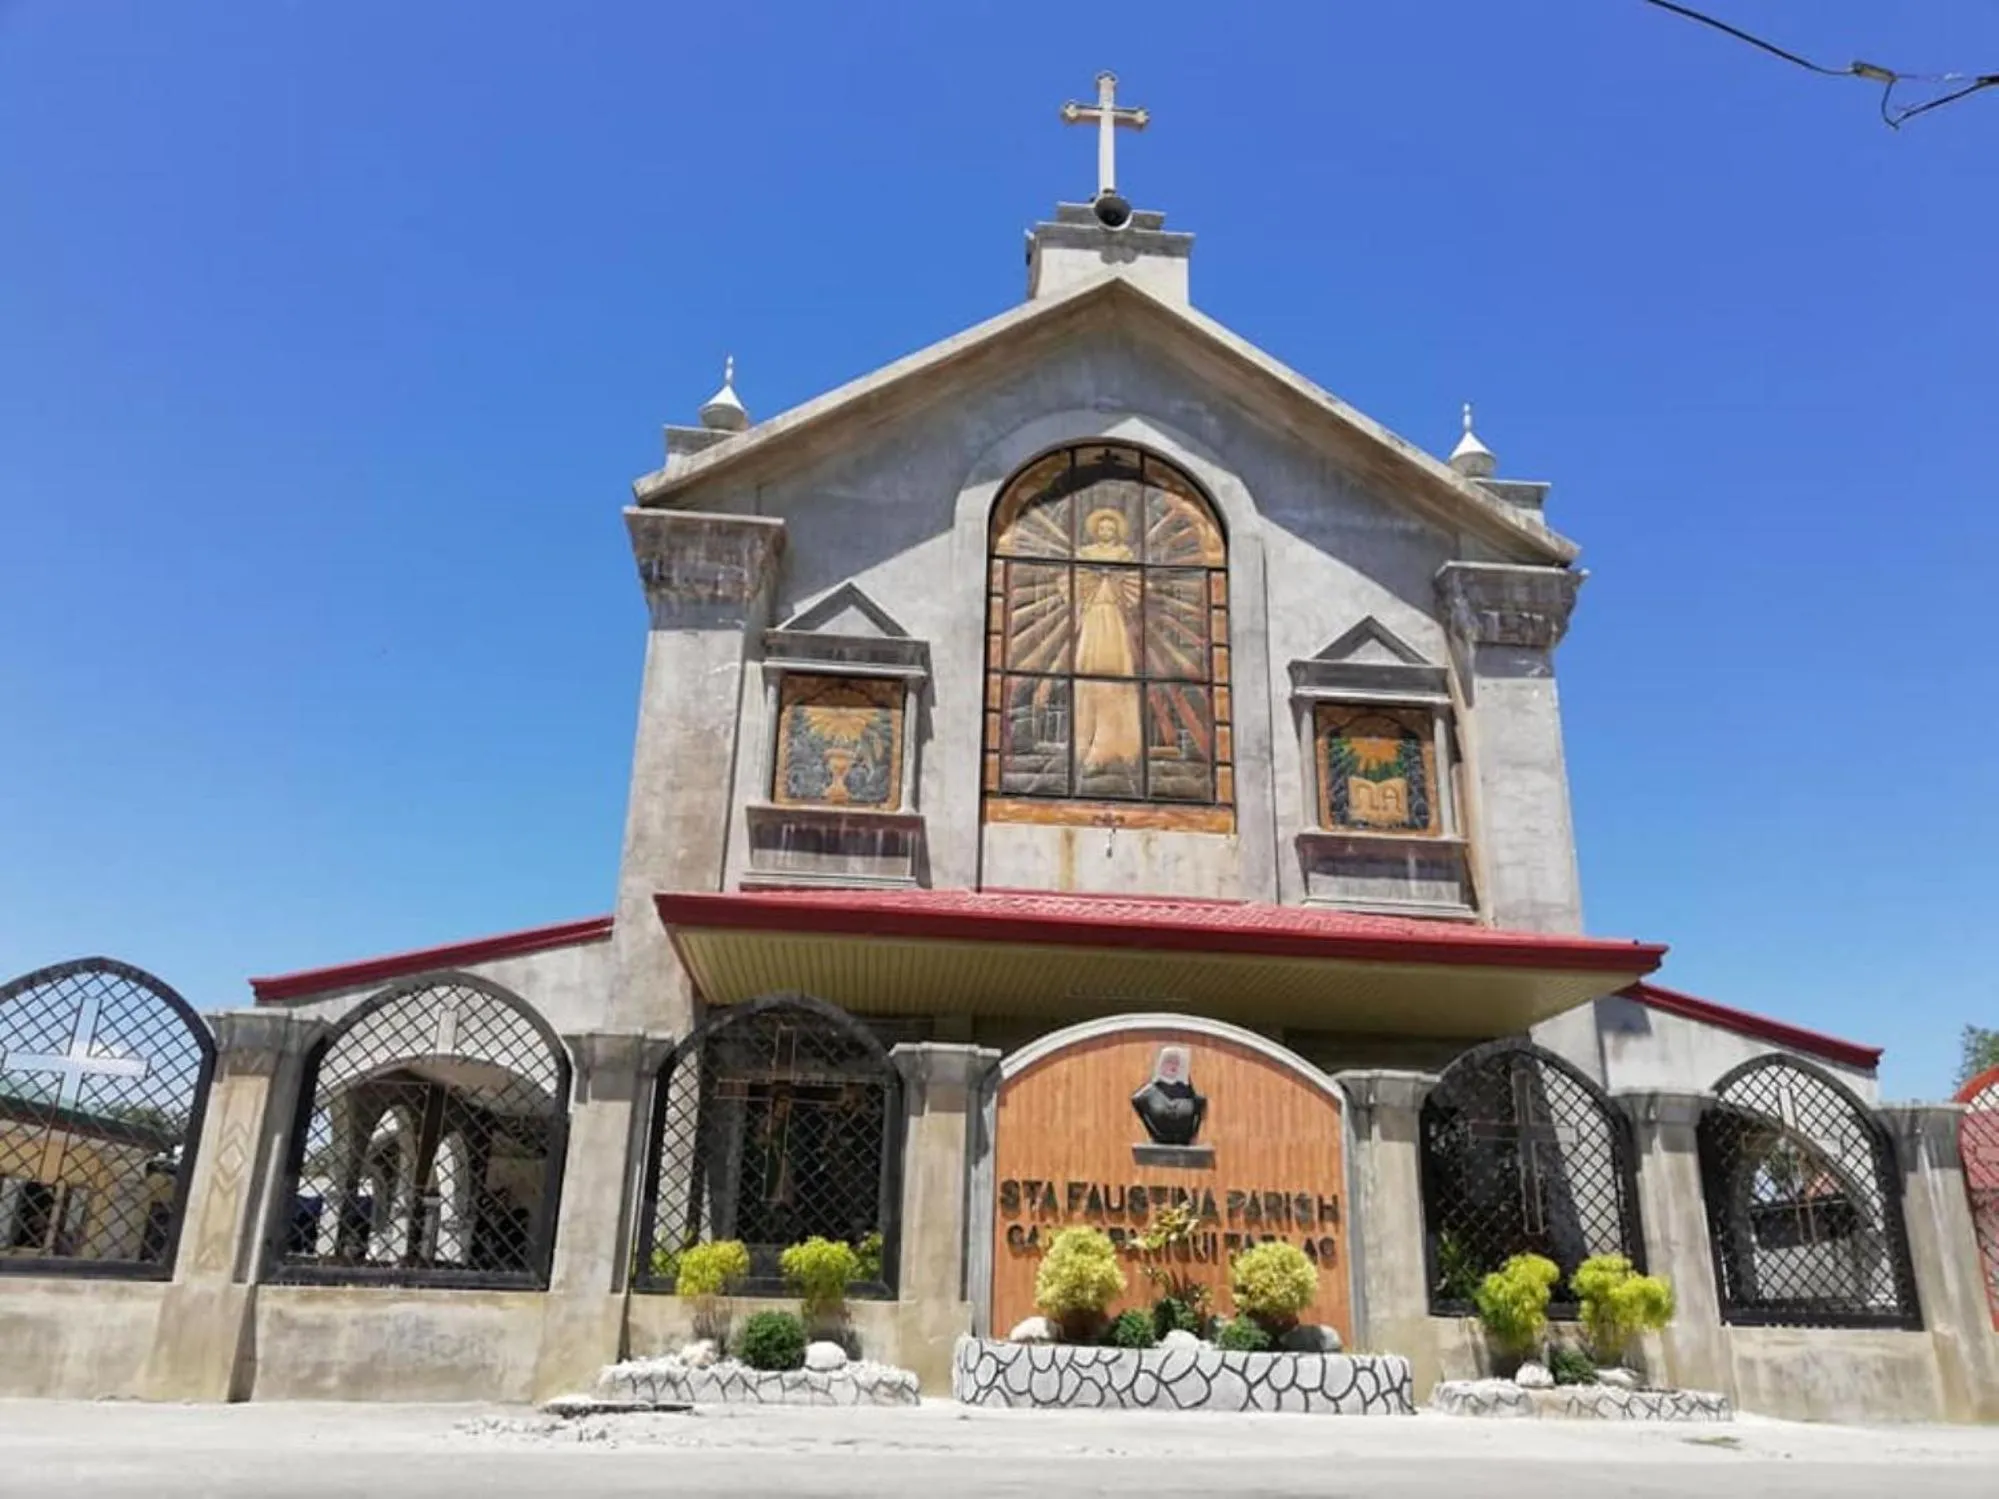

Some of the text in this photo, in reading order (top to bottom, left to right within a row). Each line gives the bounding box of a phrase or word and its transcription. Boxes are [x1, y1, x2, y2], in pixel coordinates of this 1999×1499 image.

[1000, 1179, 1339, 1223] STA FAUSTINA PARISH
[1108, 1226, 1218, 1257] PAIQUI
[1223, 1232, 1337, 1262] TAAC
